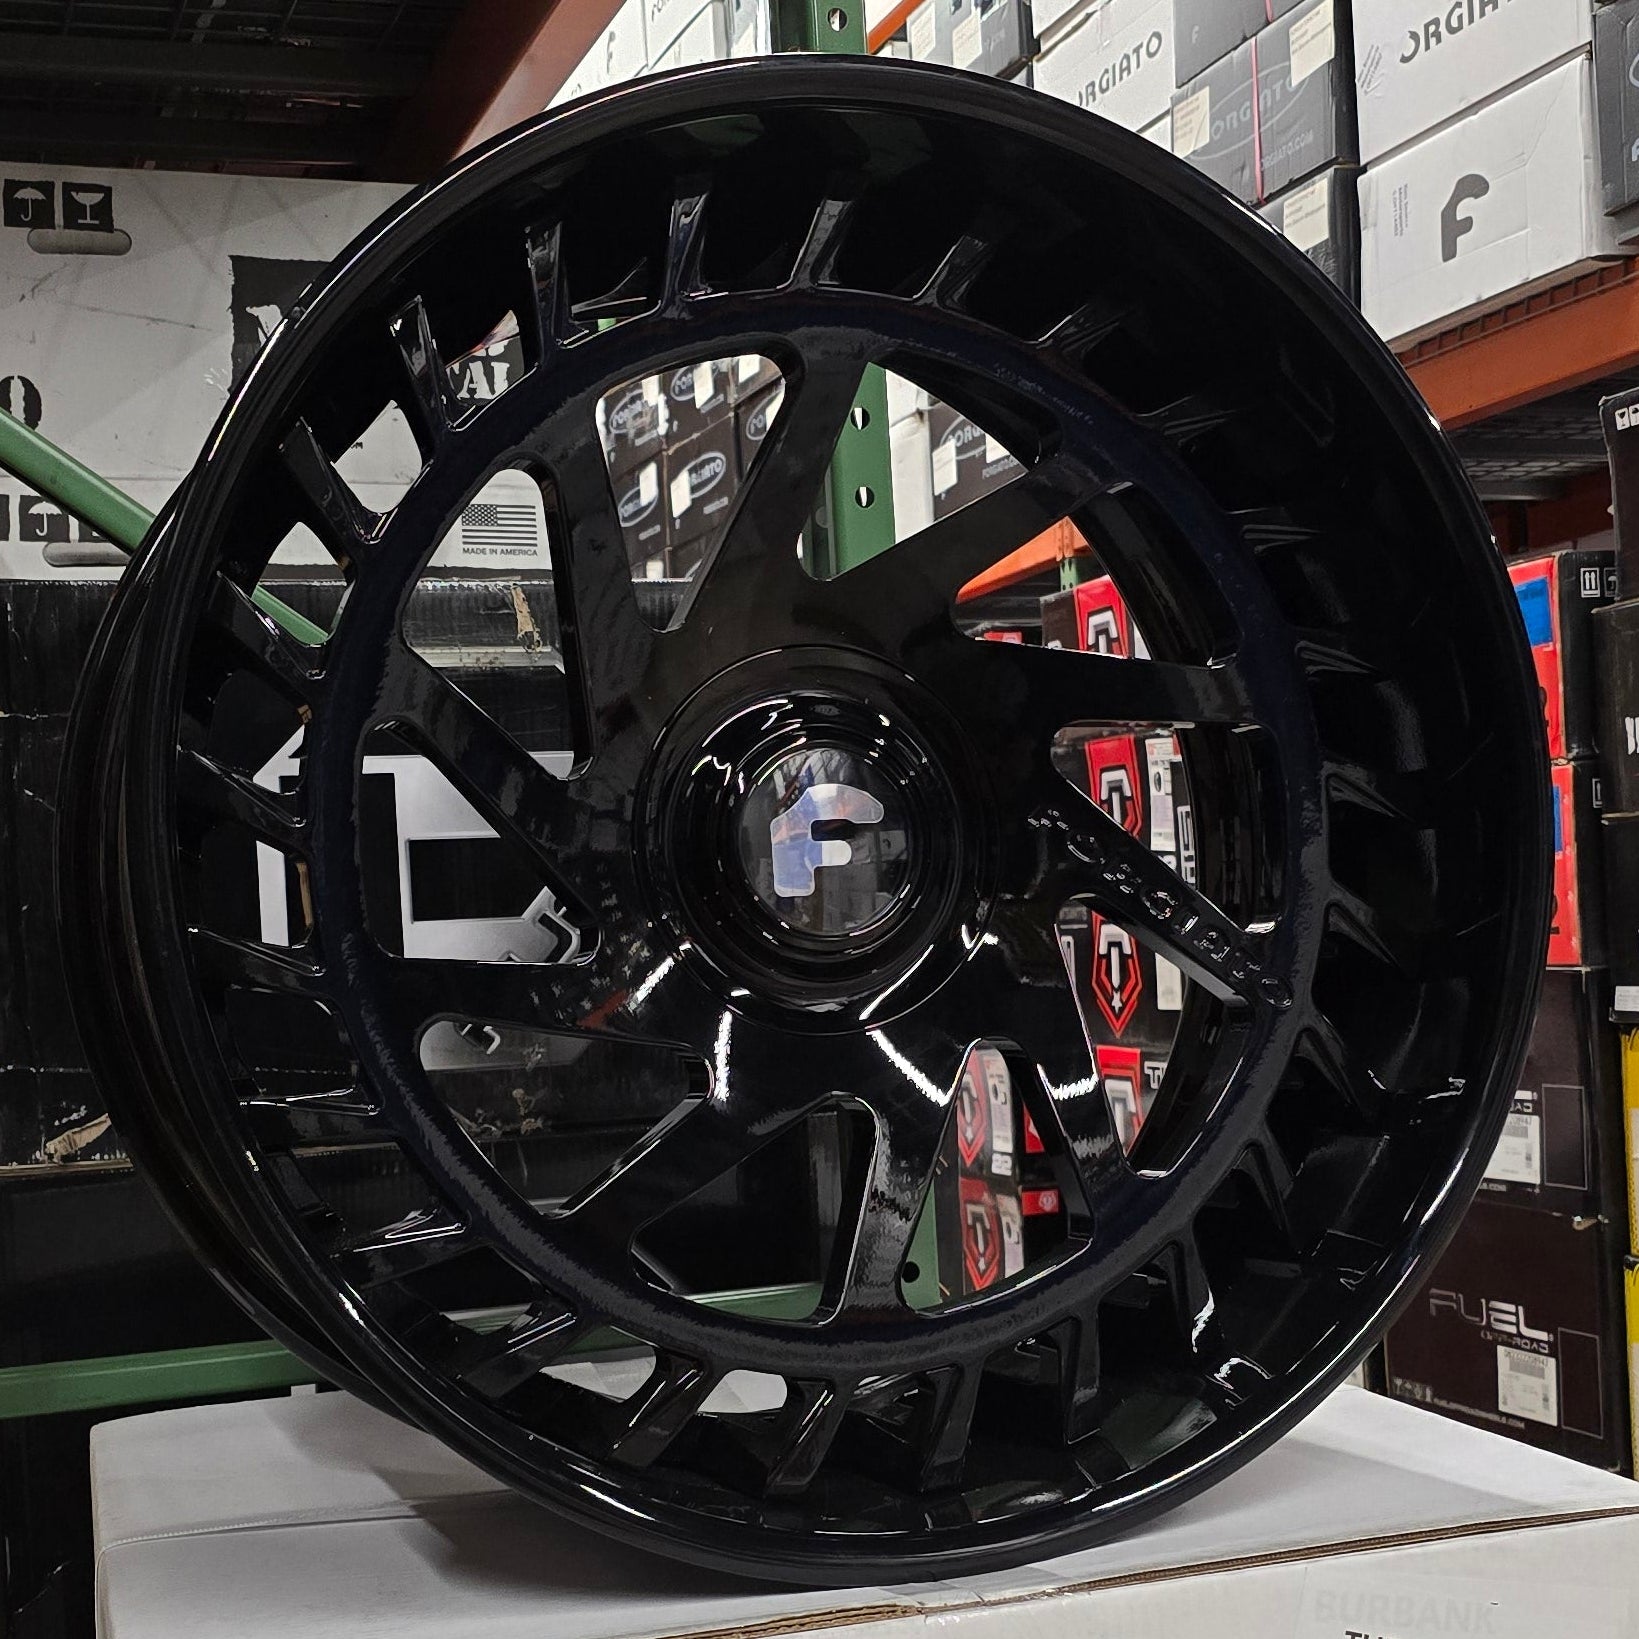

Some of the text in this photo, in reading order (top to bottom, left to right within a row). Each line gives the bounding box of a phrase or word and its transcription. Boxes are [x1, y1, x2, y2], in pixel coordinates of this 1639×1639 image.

[1440, 173, 1490, 263] F
[462, 547, 487, 555] MADE
[500, 548, 538, 557] AMERICA
[769, 783, 885, 898] F
[1429, 1287, 1549, 1342] FUEL
